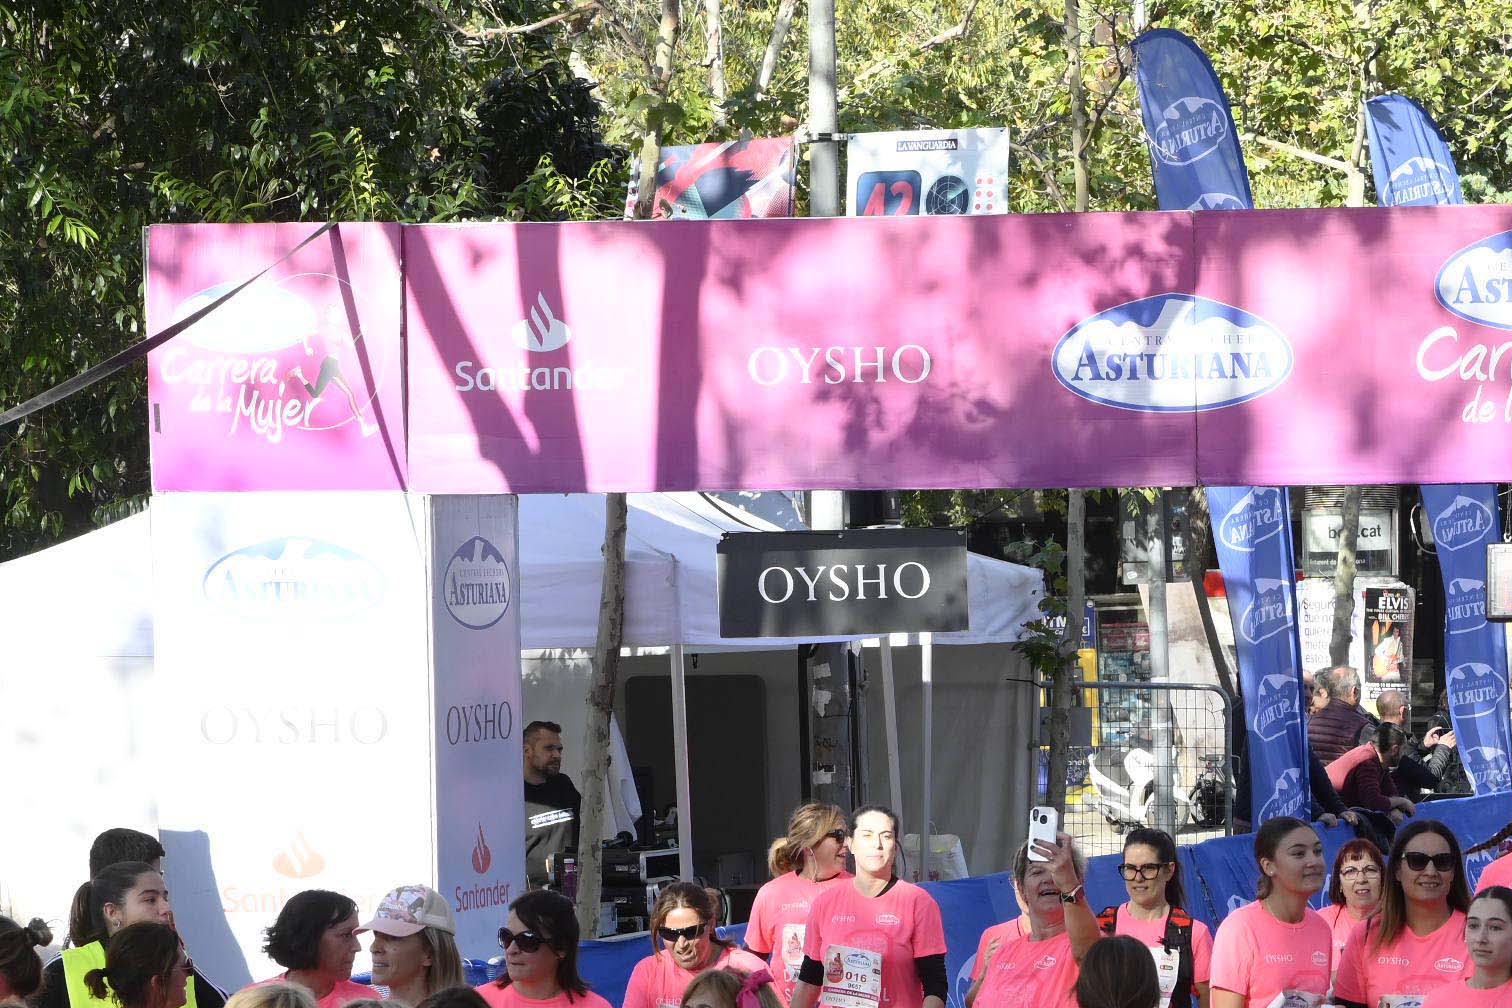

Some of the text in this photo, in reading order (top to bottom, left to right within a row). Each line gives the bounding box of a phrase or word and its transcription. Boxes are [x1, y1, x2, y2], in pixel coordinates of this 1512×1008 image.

[161, 348, 279, 385] Carrera
[748, 345, 932, 386] OYSHO
[1071, 338, 1273, 381] ASTURIANA
[229, 374, 327, 443] Mujer
[1462, 385, 1495, 423] de
[449, 571, 506, 605] ASTURIANA
[758, 562, 931, 604] OYSHO
[1378, 596, 1409, 609] ELVIS
[200, 704, 388, 745] OYSHO
[446, 701, 512, 746] OYSHO
[456, 883, 510, 913] Santander
[846, 971, 868, 983] 016
